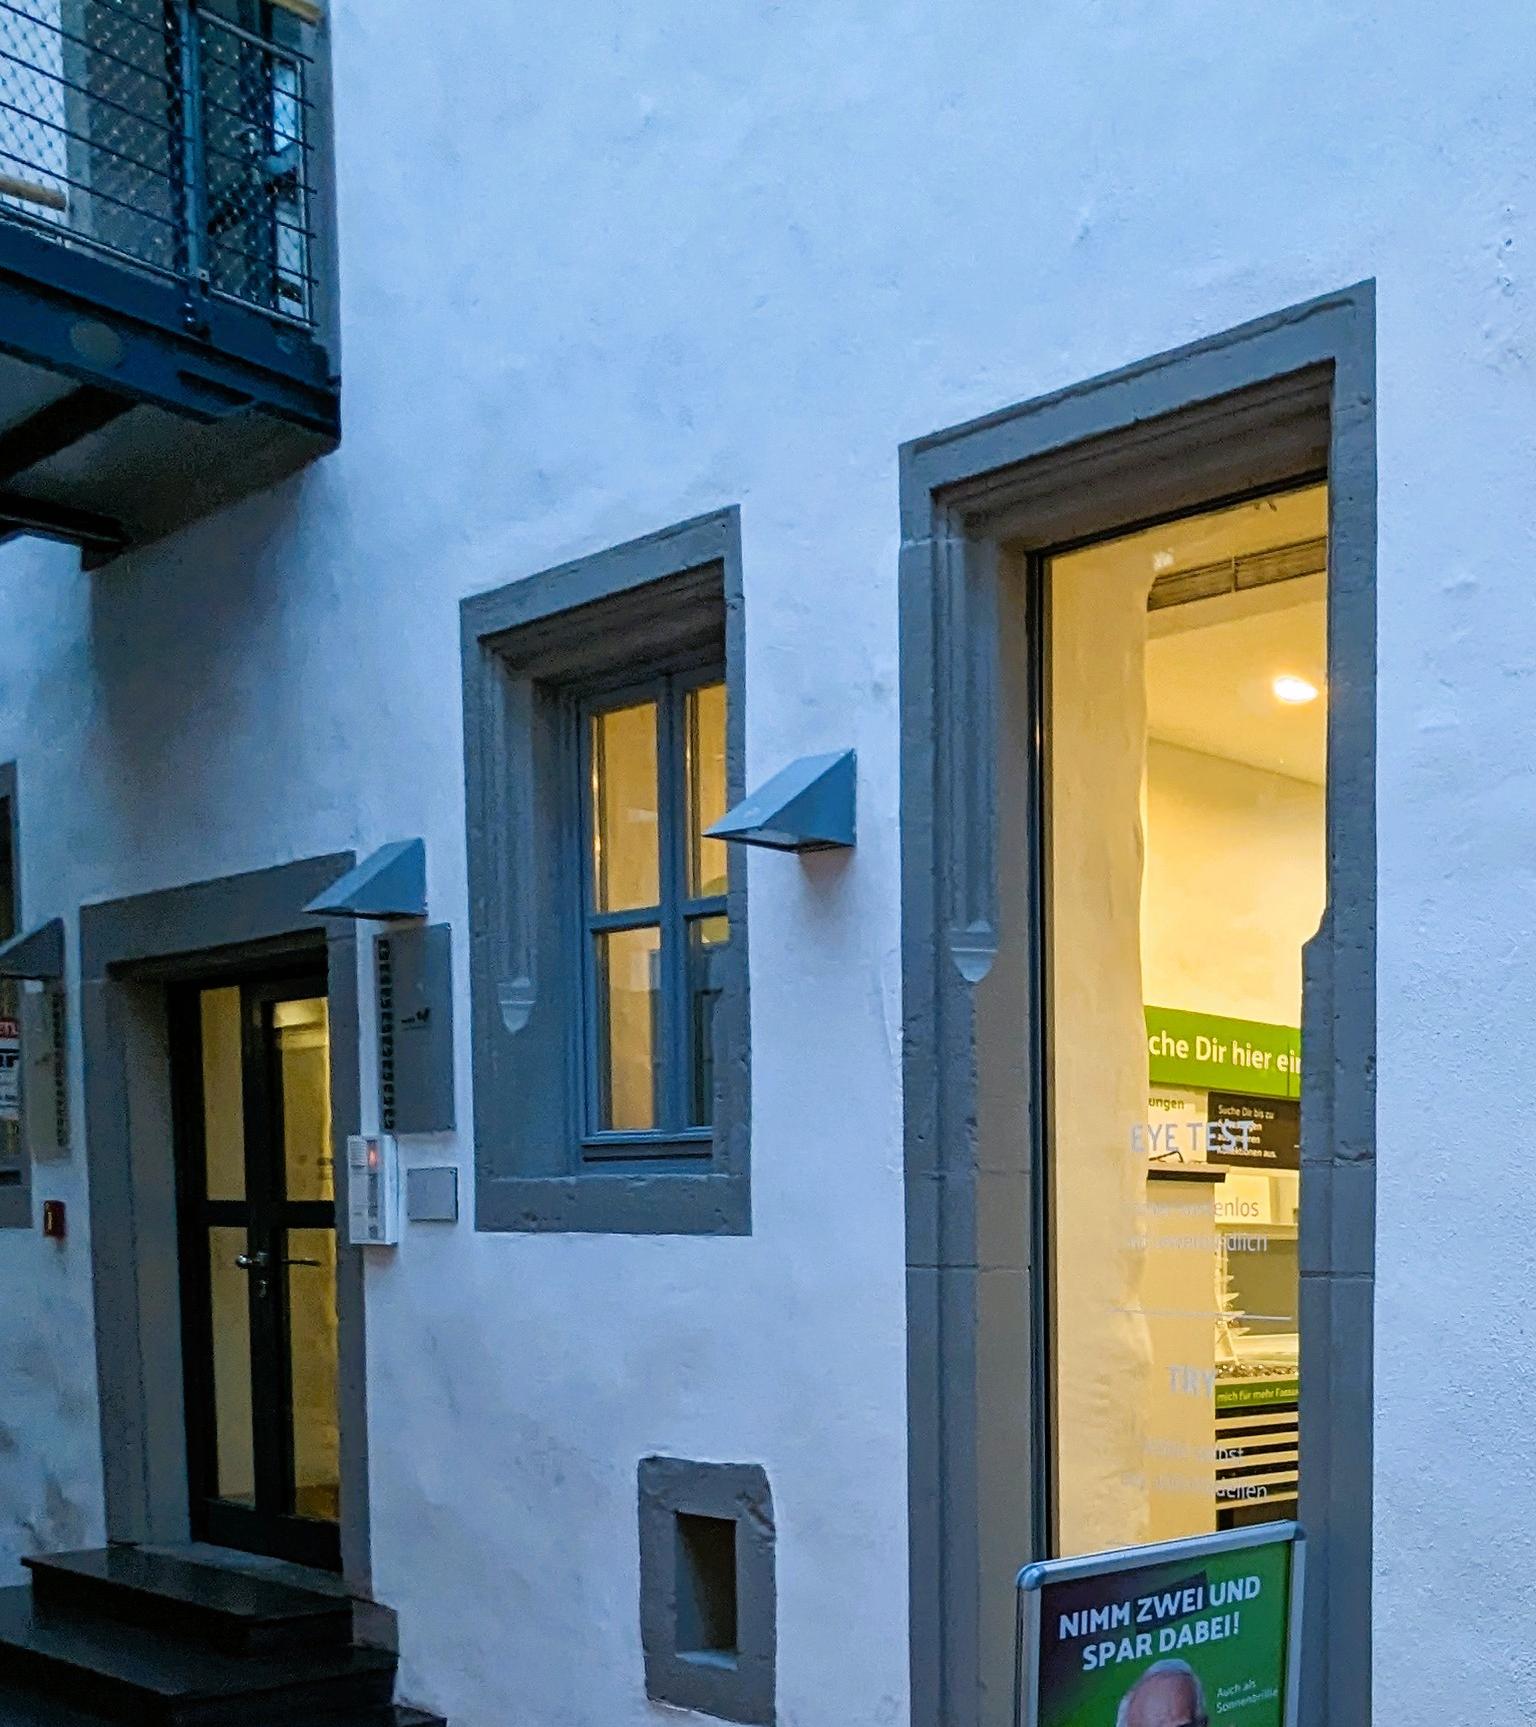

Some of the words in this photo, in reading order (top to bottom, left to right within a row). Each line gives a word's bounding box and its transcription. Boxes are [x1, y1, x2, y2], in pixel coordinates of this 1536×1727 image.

[1148, 1030, 1190, 1059] che
[1195, 1036, 1227, 1063] Dir
[1232, 1040, 1272, 1070] hier
[1148, 1098, 1185, 1111] ungen
[1218, 1104, 1240, 1117] Suche
[1241, 1106, 1253, 1117] Dir
[1253, 1108, 1264, 1119] bis
[1265, 1111, 1275, 1120] zu
[1131, 1121, 1179, 1153] EYE
[1186, 1119, 1255, 1152] TEST
[1059, 1601, 1131, 1640] NIMM
[1136, 1586, 1203, 1623] ZWEI
[1208, 1575, 1261, 1607] UND
[1081, 1633, 1153, 1671] SPAR
[1158, 1611, 1240, 1652] DABEI!
